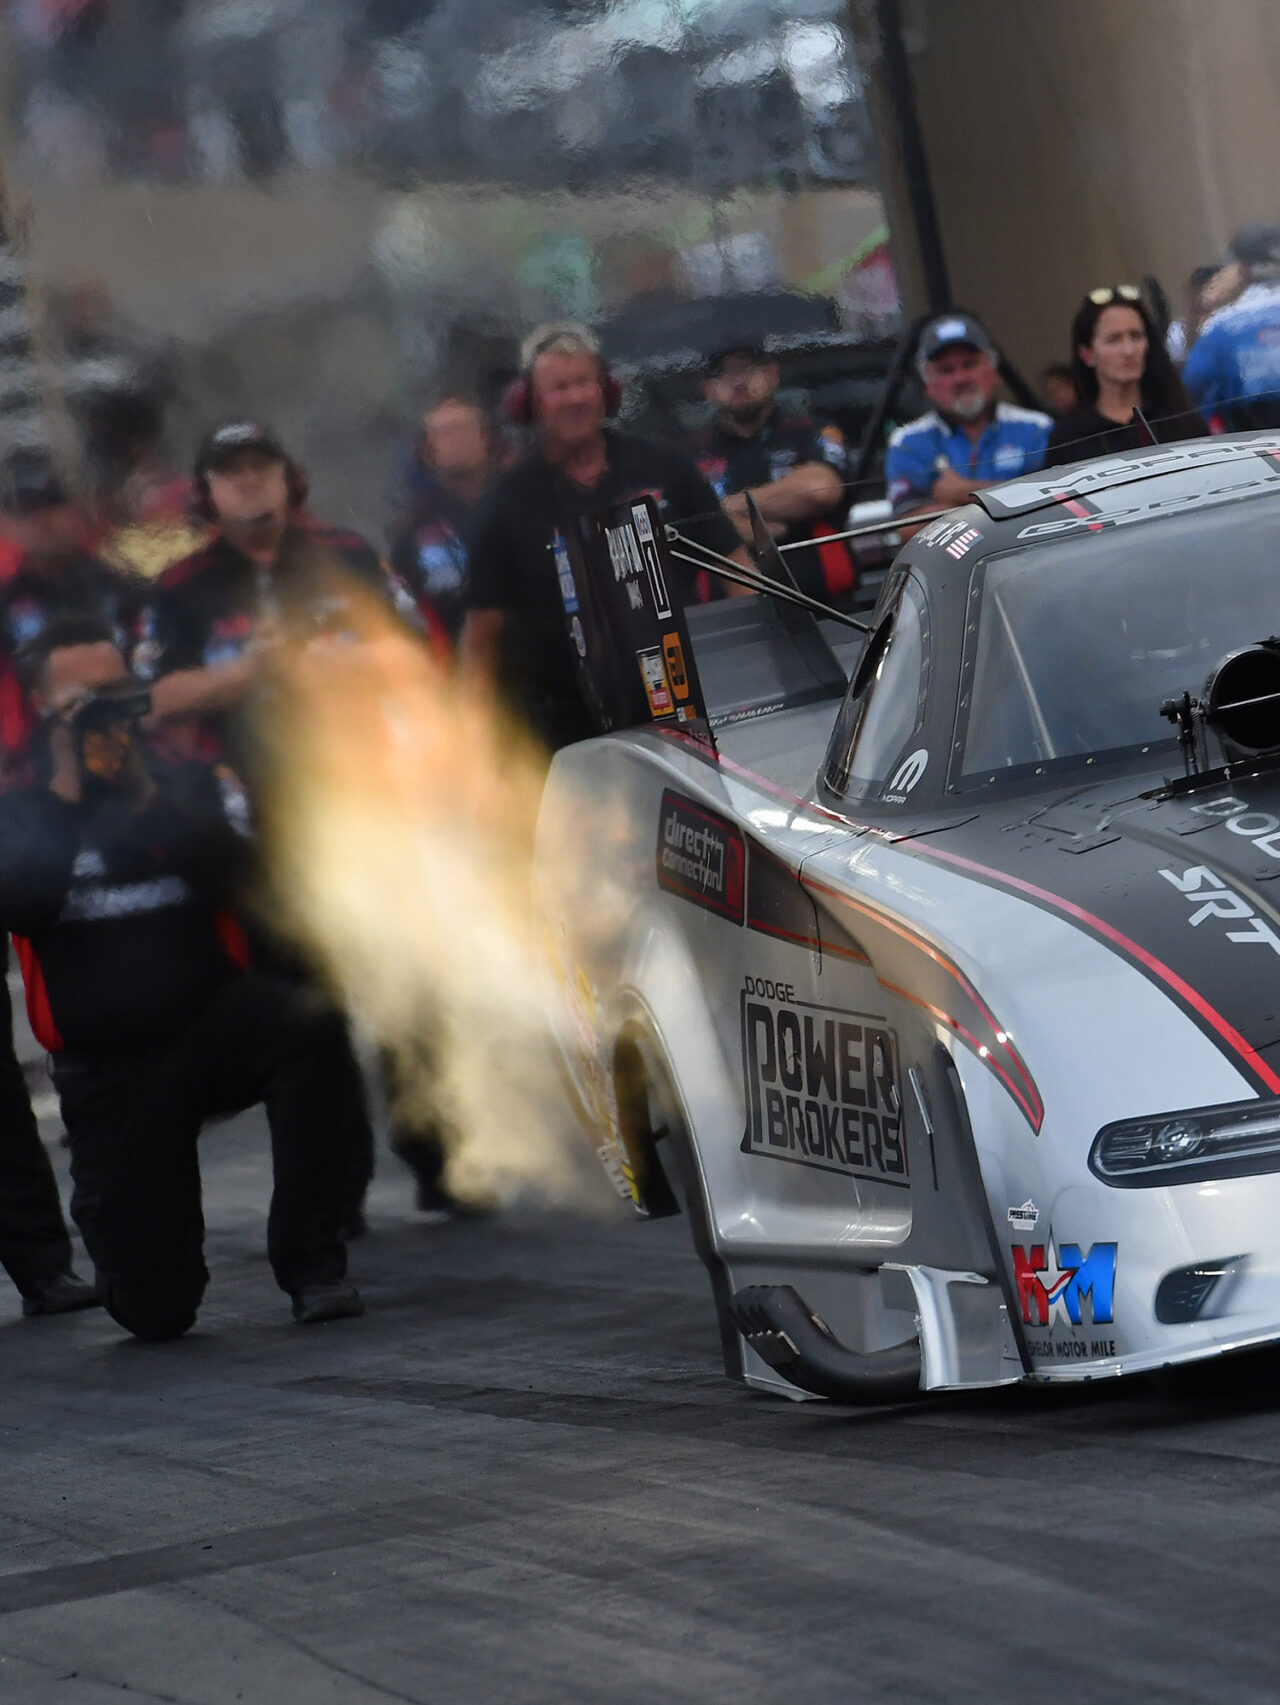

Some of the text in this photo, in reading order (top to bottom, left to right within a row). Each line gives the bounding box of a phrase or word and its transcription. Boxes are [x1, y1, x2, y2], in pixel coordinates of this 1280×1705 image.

[745, 975, 796, 1004] DODGE
[747, 1002, 897, 1143] POWER
[766, 1087, 905, 1175] BROKERS
[1056, 1340, 1088, 1358] MOTOR
[1091, 1340, 1116, 1356] MILE
